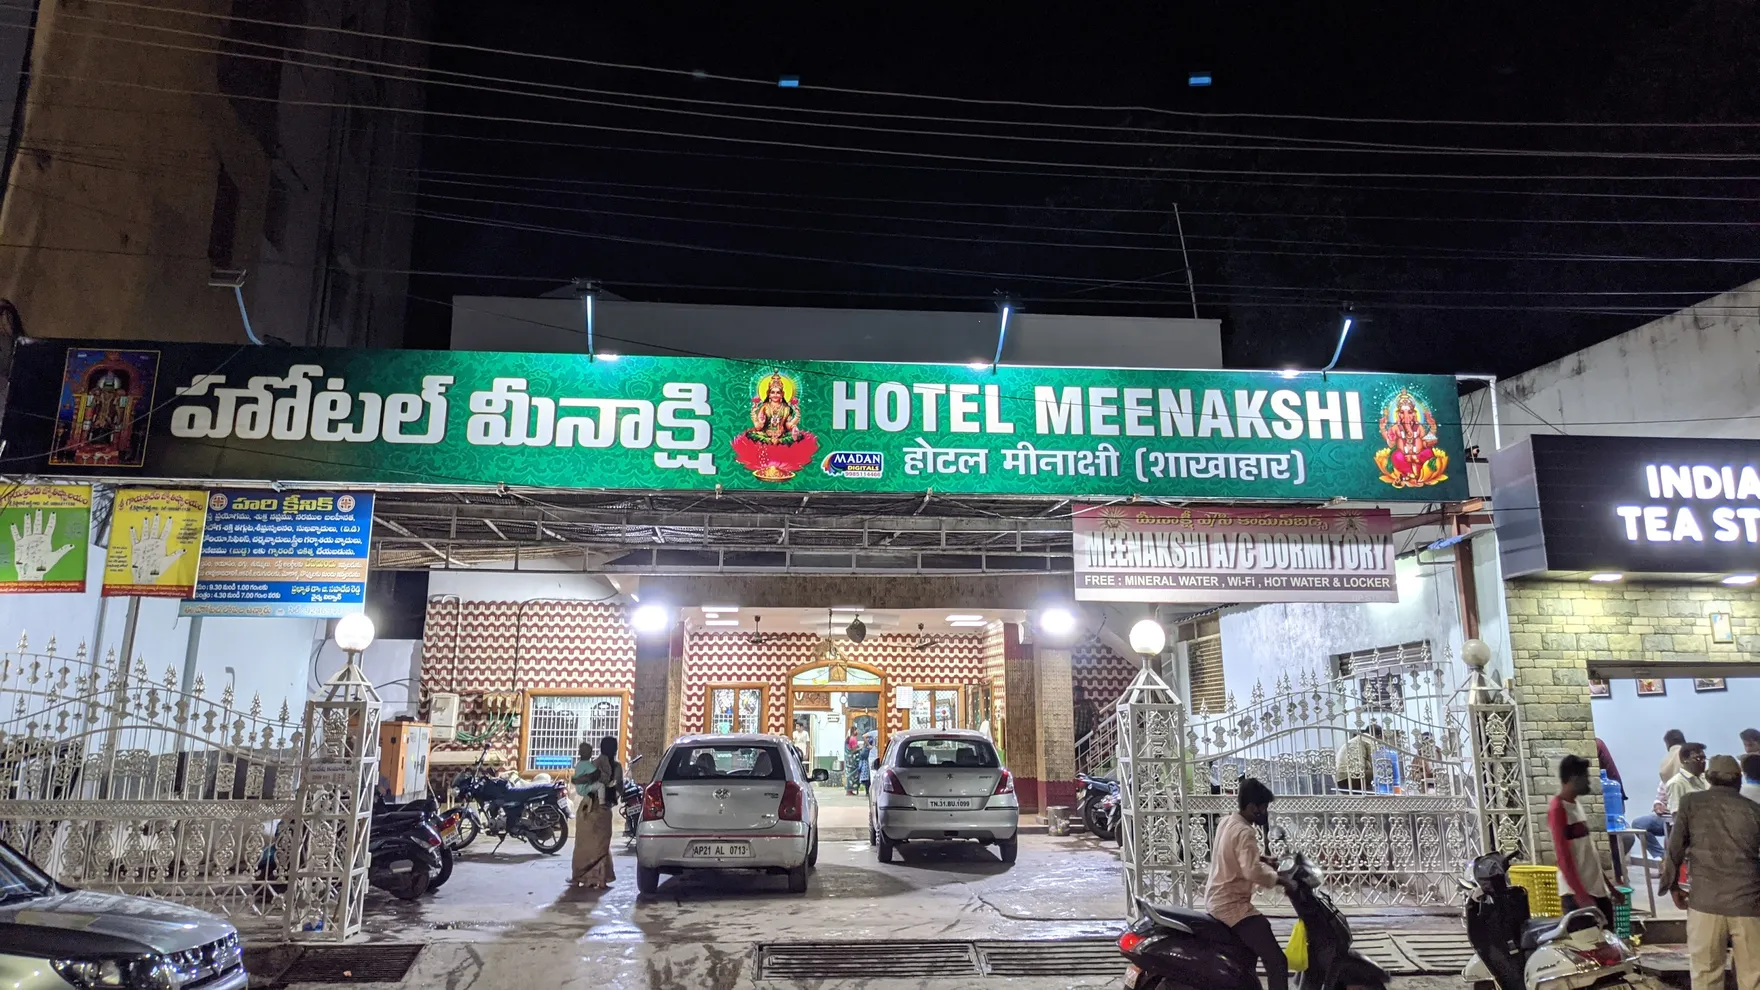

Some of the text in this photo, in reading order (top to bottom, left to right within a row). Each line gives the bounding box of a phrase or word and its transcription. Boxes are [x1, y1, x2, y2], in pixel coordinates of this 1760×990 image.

[170, 364, 718, 475] హోటల్ మీనాక్షి
[832, 380, 1364, 440] HOTEL MEENAKSHI
[834, 453, 881, 464] MADAN
[903, 436, 1306, 485] होटल मीनाक्षी (शाखाहार)
[1645, 464, 1760, 500] INDIA
[1616, 506, 1760, 543] TEA ST
[1086, 531, 1389, 571] MEENAKSHI A/C DORMITORY
[1084, 575, 1391, 589] FREE MINERAL WATER Wi-Fi HOT WATER & LOCKER
[693, 845, 747, 855] AP21 AL 0713
